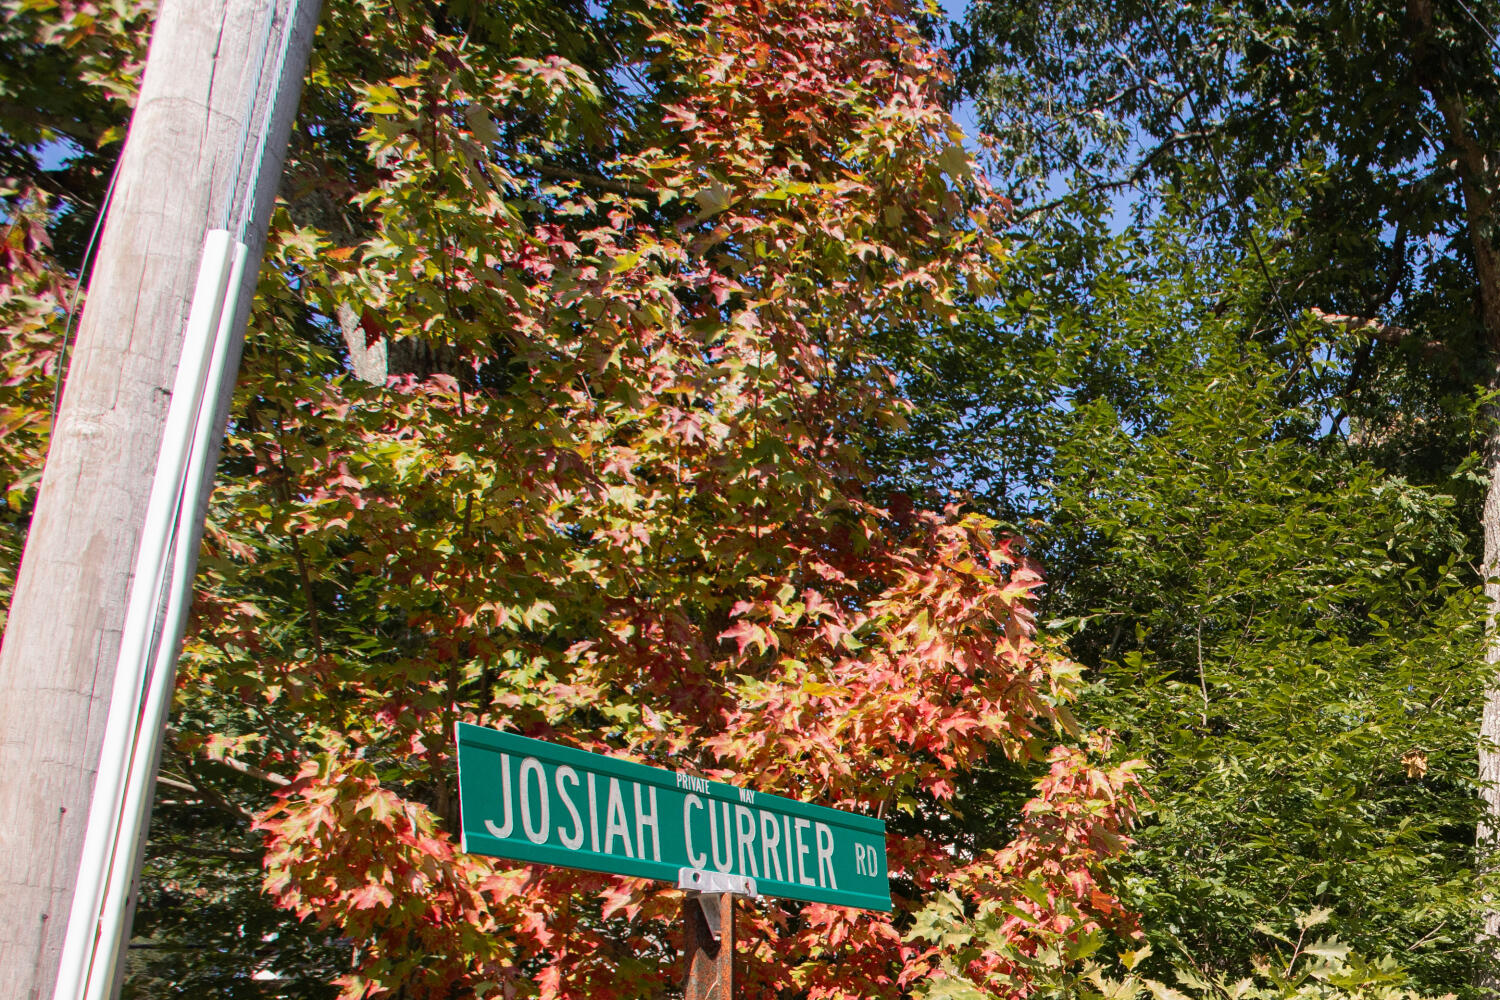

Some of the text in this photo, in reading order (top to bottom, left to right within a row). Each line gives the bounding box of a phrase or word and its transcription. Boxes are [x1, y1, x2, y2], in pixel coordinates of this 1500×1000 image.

[484, 753, 878, 889] JOSIAH CURRIER RD
[676, 773, 755, 804] PRIVATE WAY
